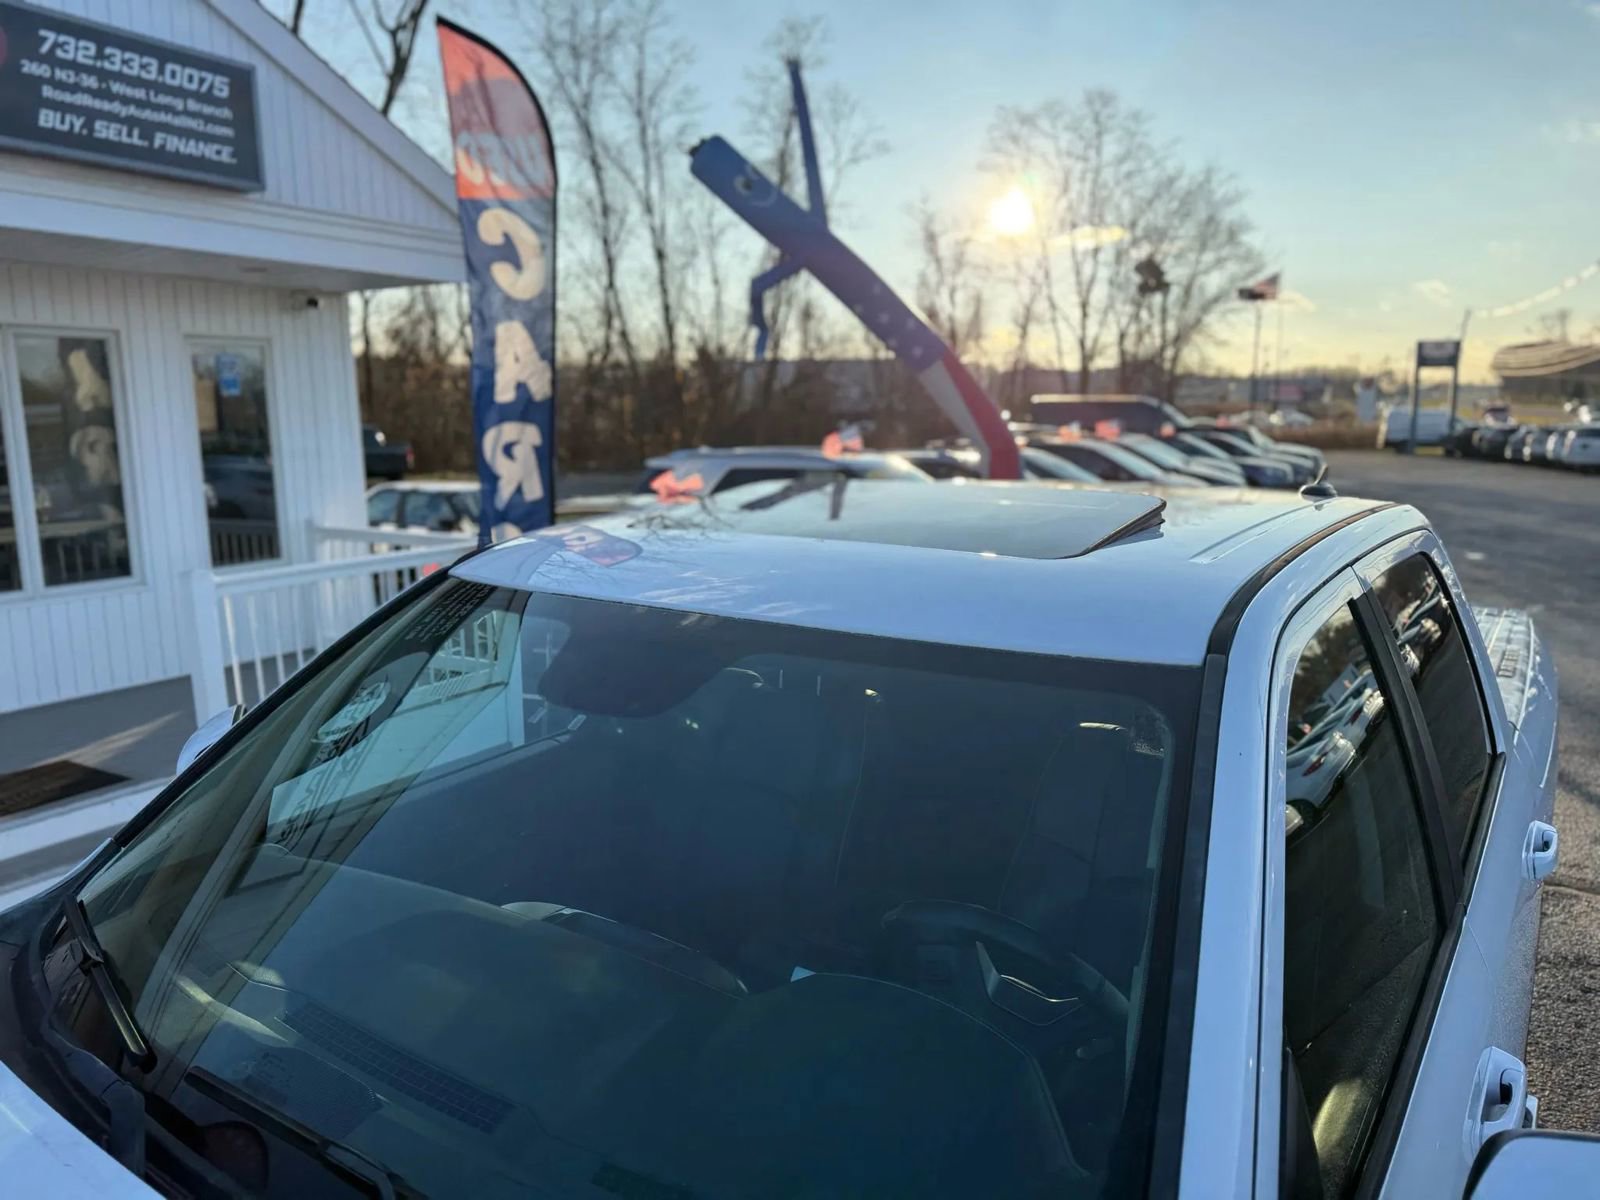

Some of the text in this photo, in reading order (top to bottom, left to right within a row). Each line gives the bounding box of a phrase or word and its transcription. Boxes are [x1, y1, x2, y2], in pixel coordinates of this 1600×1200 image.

[38, 29, 231, 98] 732.333.0075
[108, 79, 147, 101] West
[149, 89, 184, 111] Long
[186, 97, 234, 120] Branch
[37, 107, 237, 164] BUY. SELL. FINANCE.
